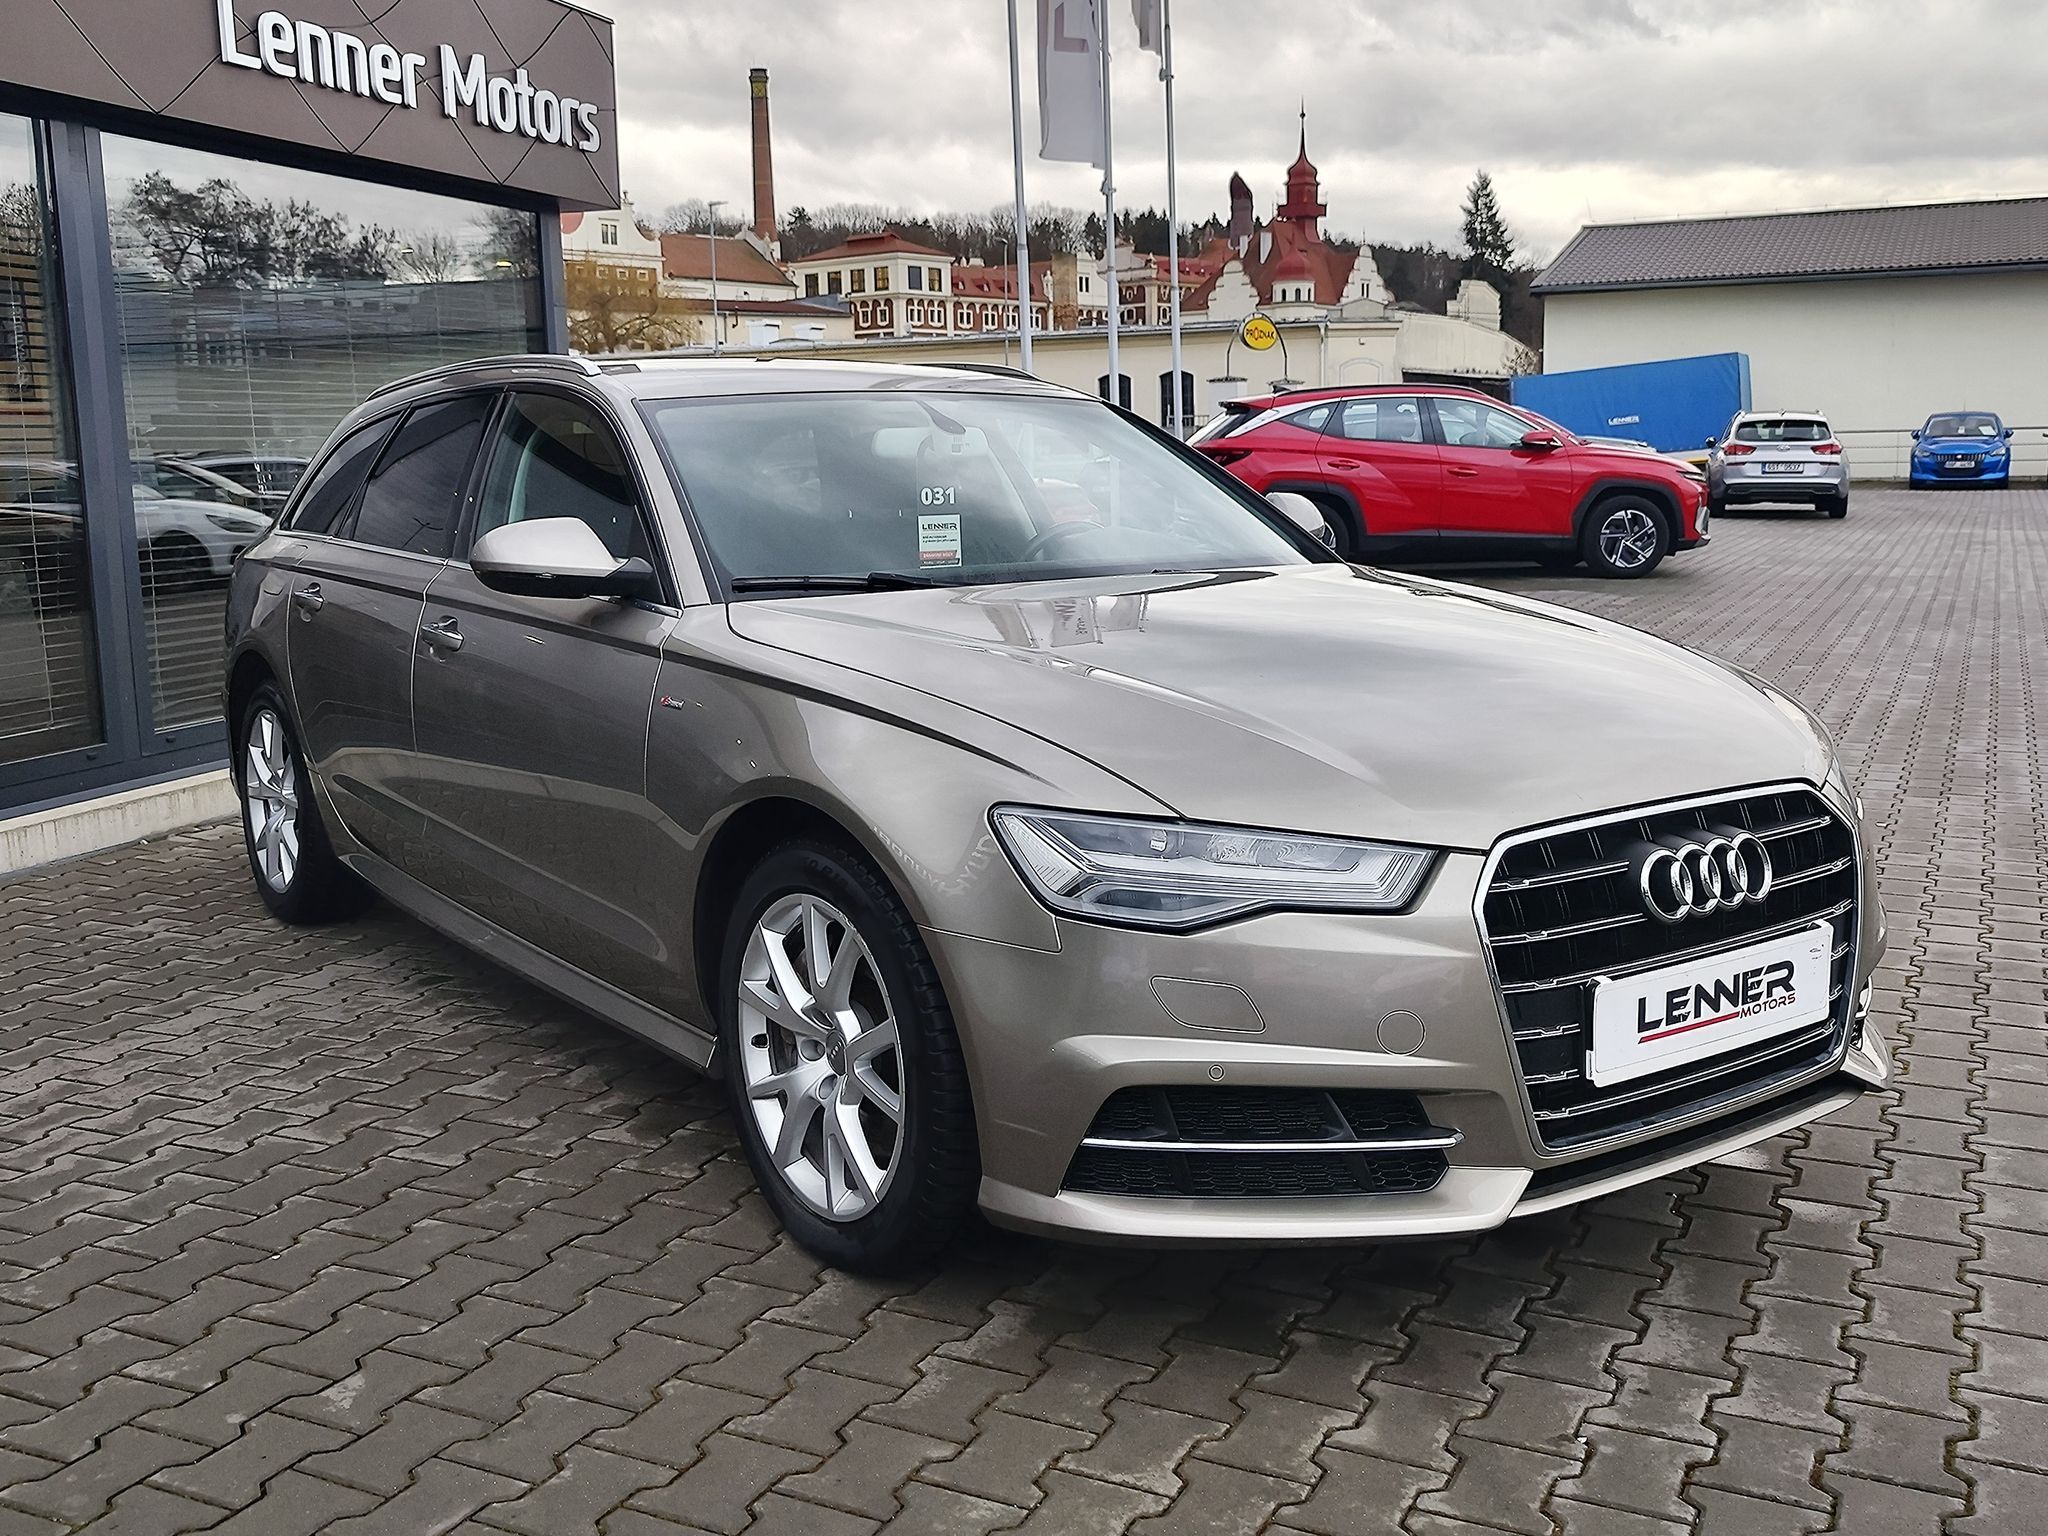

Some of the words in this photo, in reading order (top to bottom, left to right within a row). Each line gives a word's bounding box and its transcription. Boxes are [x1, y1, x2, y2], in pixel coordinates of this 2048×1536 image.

[216, 0, 426, 109] Lenner
[439, 43, 601, 152] Motors
[920, 486, 956, 506] 031
[921, 522, 958, 531] LENNER
[1637, 960, 1796, 1034] LENNER
[1739, 993, 1797, 1019] MOTORS
